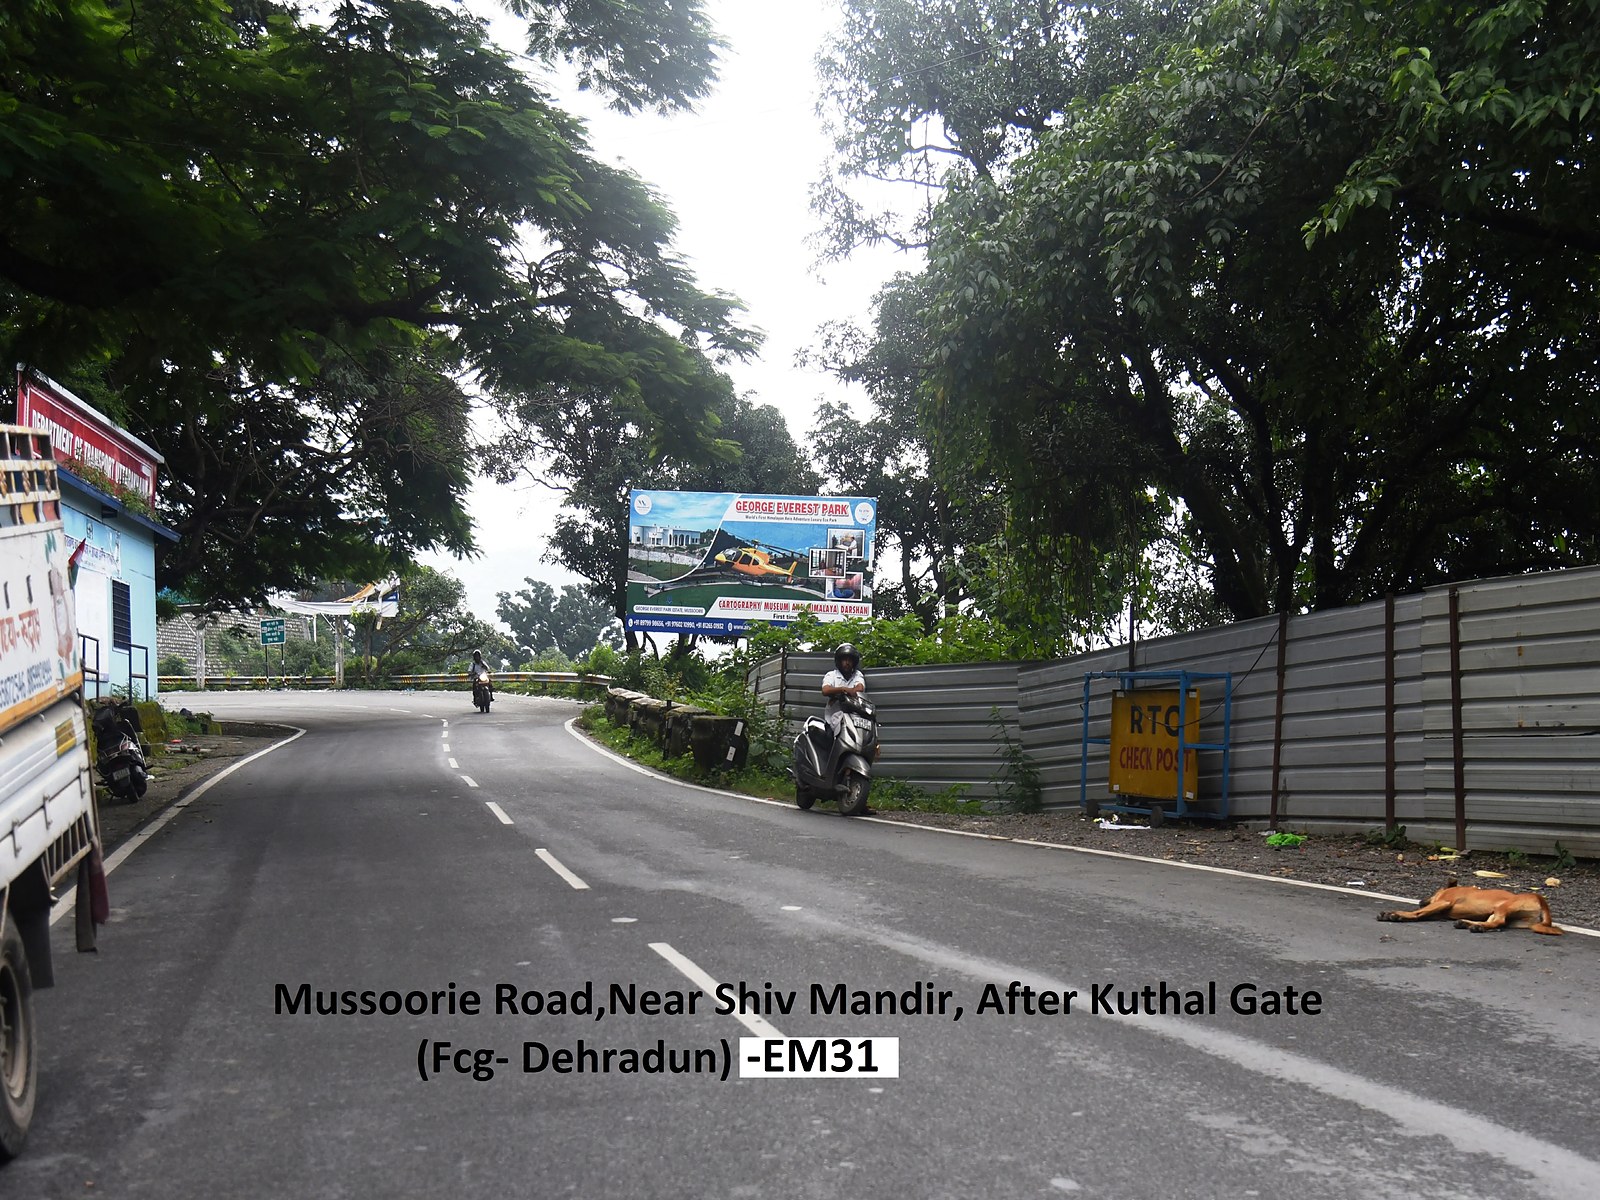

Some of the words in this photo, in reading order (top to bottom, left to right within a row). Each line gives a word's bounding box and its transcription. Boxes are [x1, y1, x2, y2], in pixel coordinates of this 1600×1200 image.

[74, 435, 84, 460] OF
[736, 500, 774, 514] GEORGE
[776, 502, 820, 516] EVEREST
[821, 503, 849, 517] PARK
[718, 600, 761, 610] CARTOGRAPHY
[763, 601, 789, 611] MUSEUM
[840, 604, 870, 615] DARSHAN
[1119, 746, 1152, 771] CHECK
[1156, 747, 1192, 773] POST
